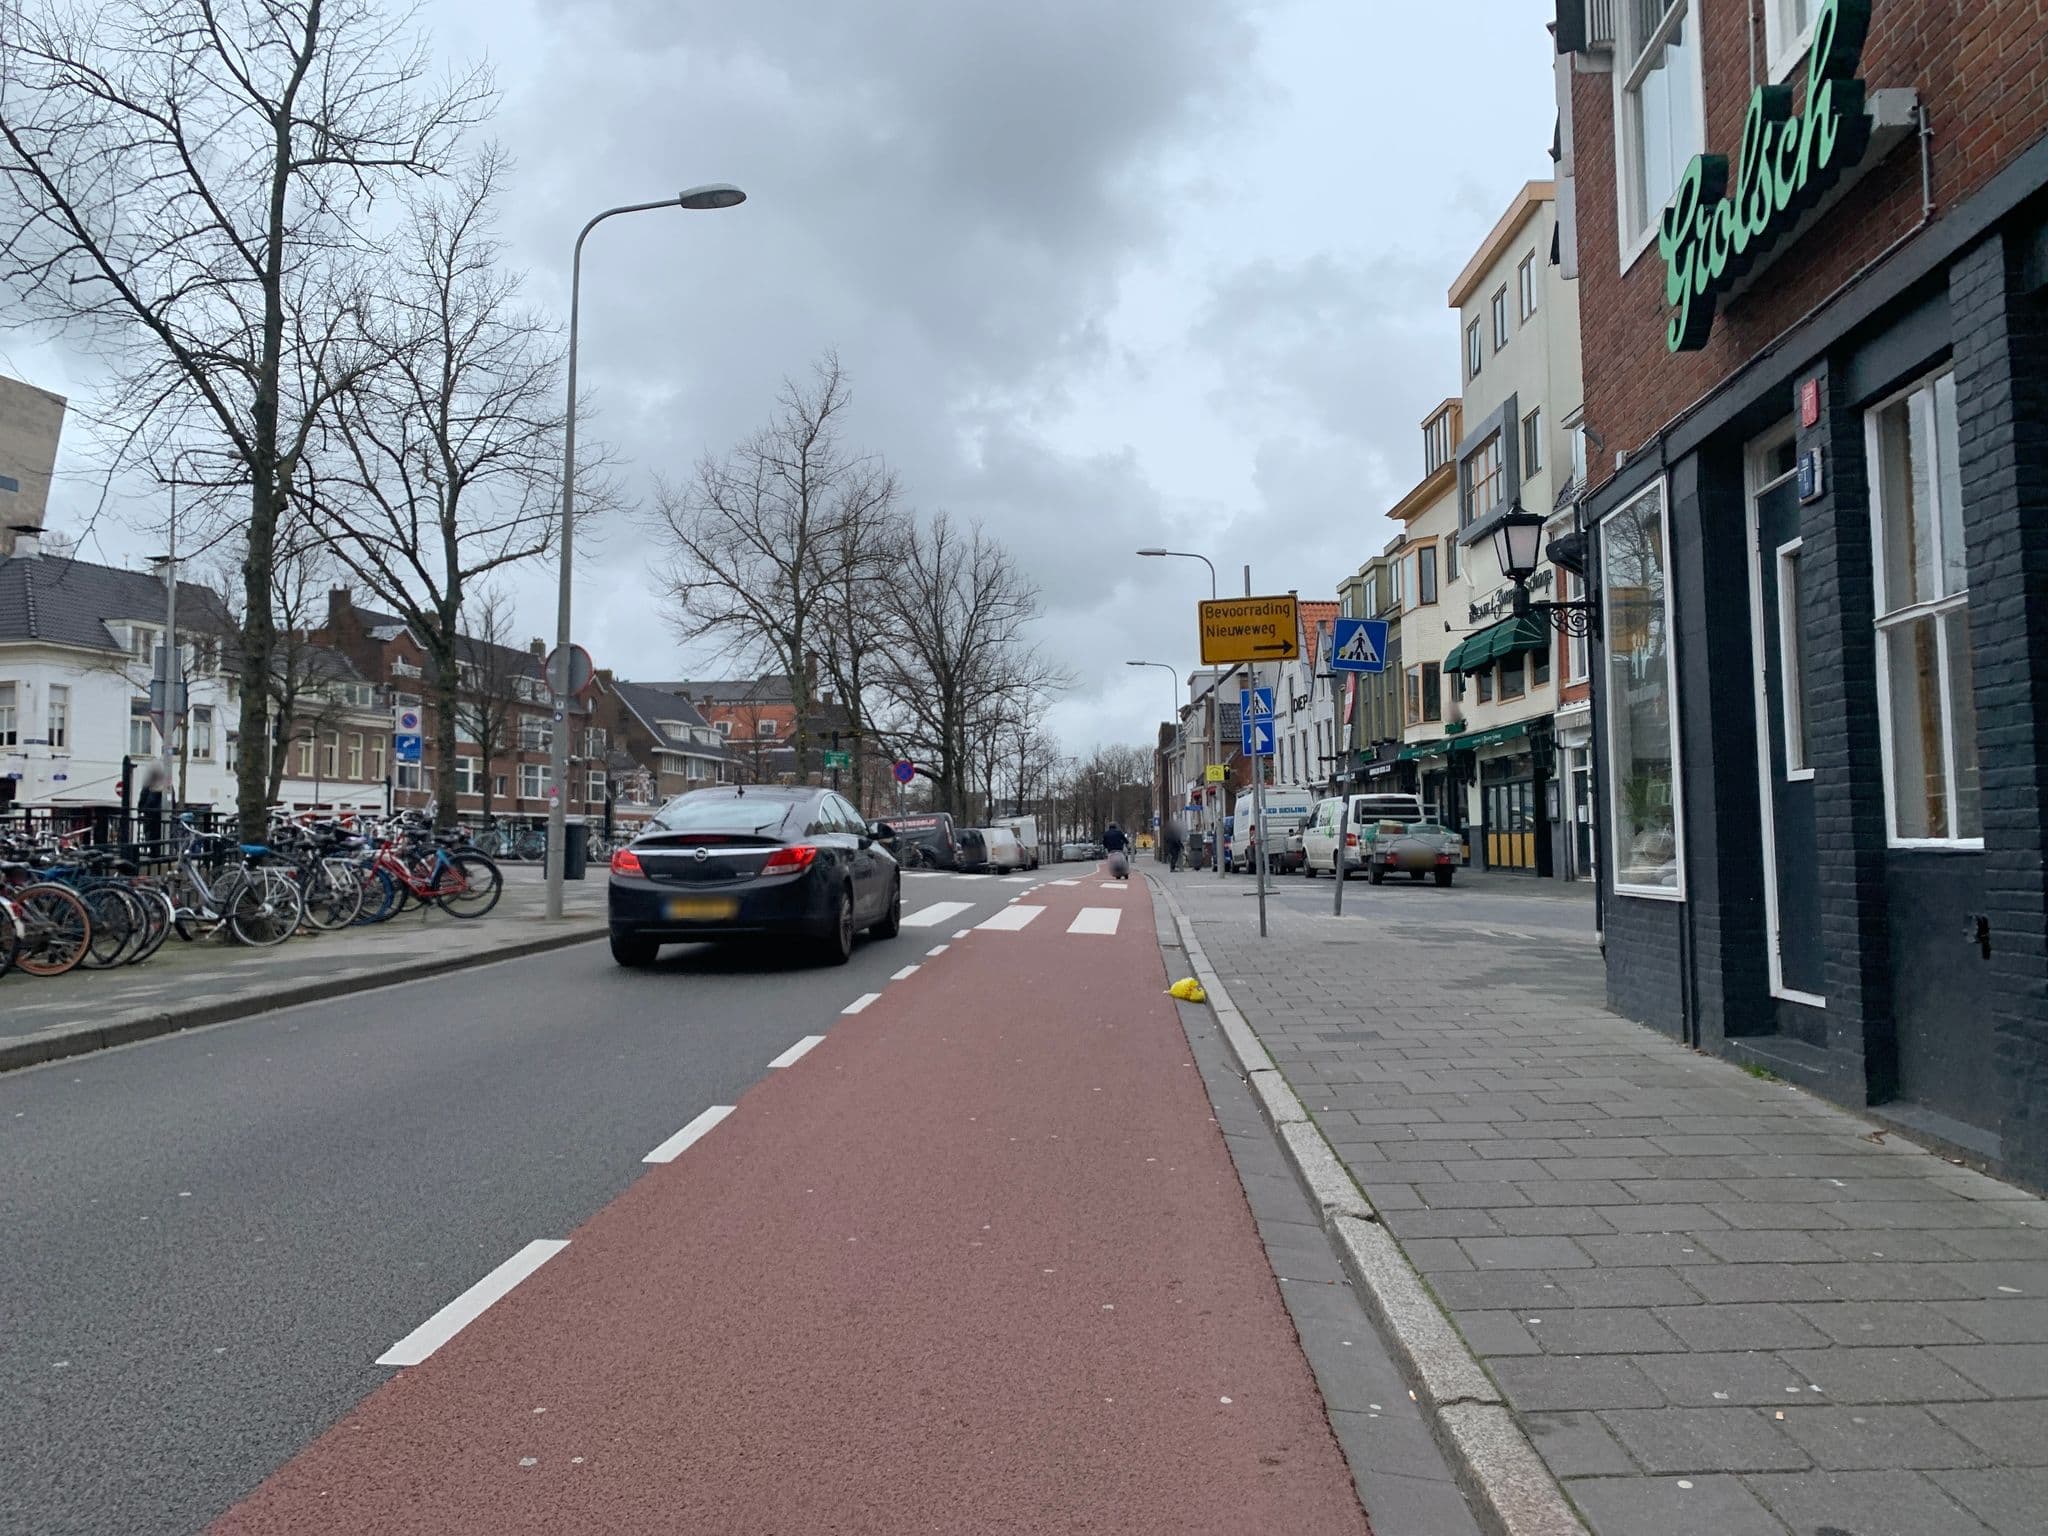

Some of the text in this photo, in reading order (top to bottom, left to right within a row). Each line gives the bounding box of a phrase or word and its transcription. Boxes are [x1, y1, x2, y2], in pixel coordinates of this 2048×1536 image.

[1660, 0, 1839, 352] Grolsch
[1205, 603, 1290, 619] Bevoorrading
[1206, 623, 1276, 638] Nieuweweg
